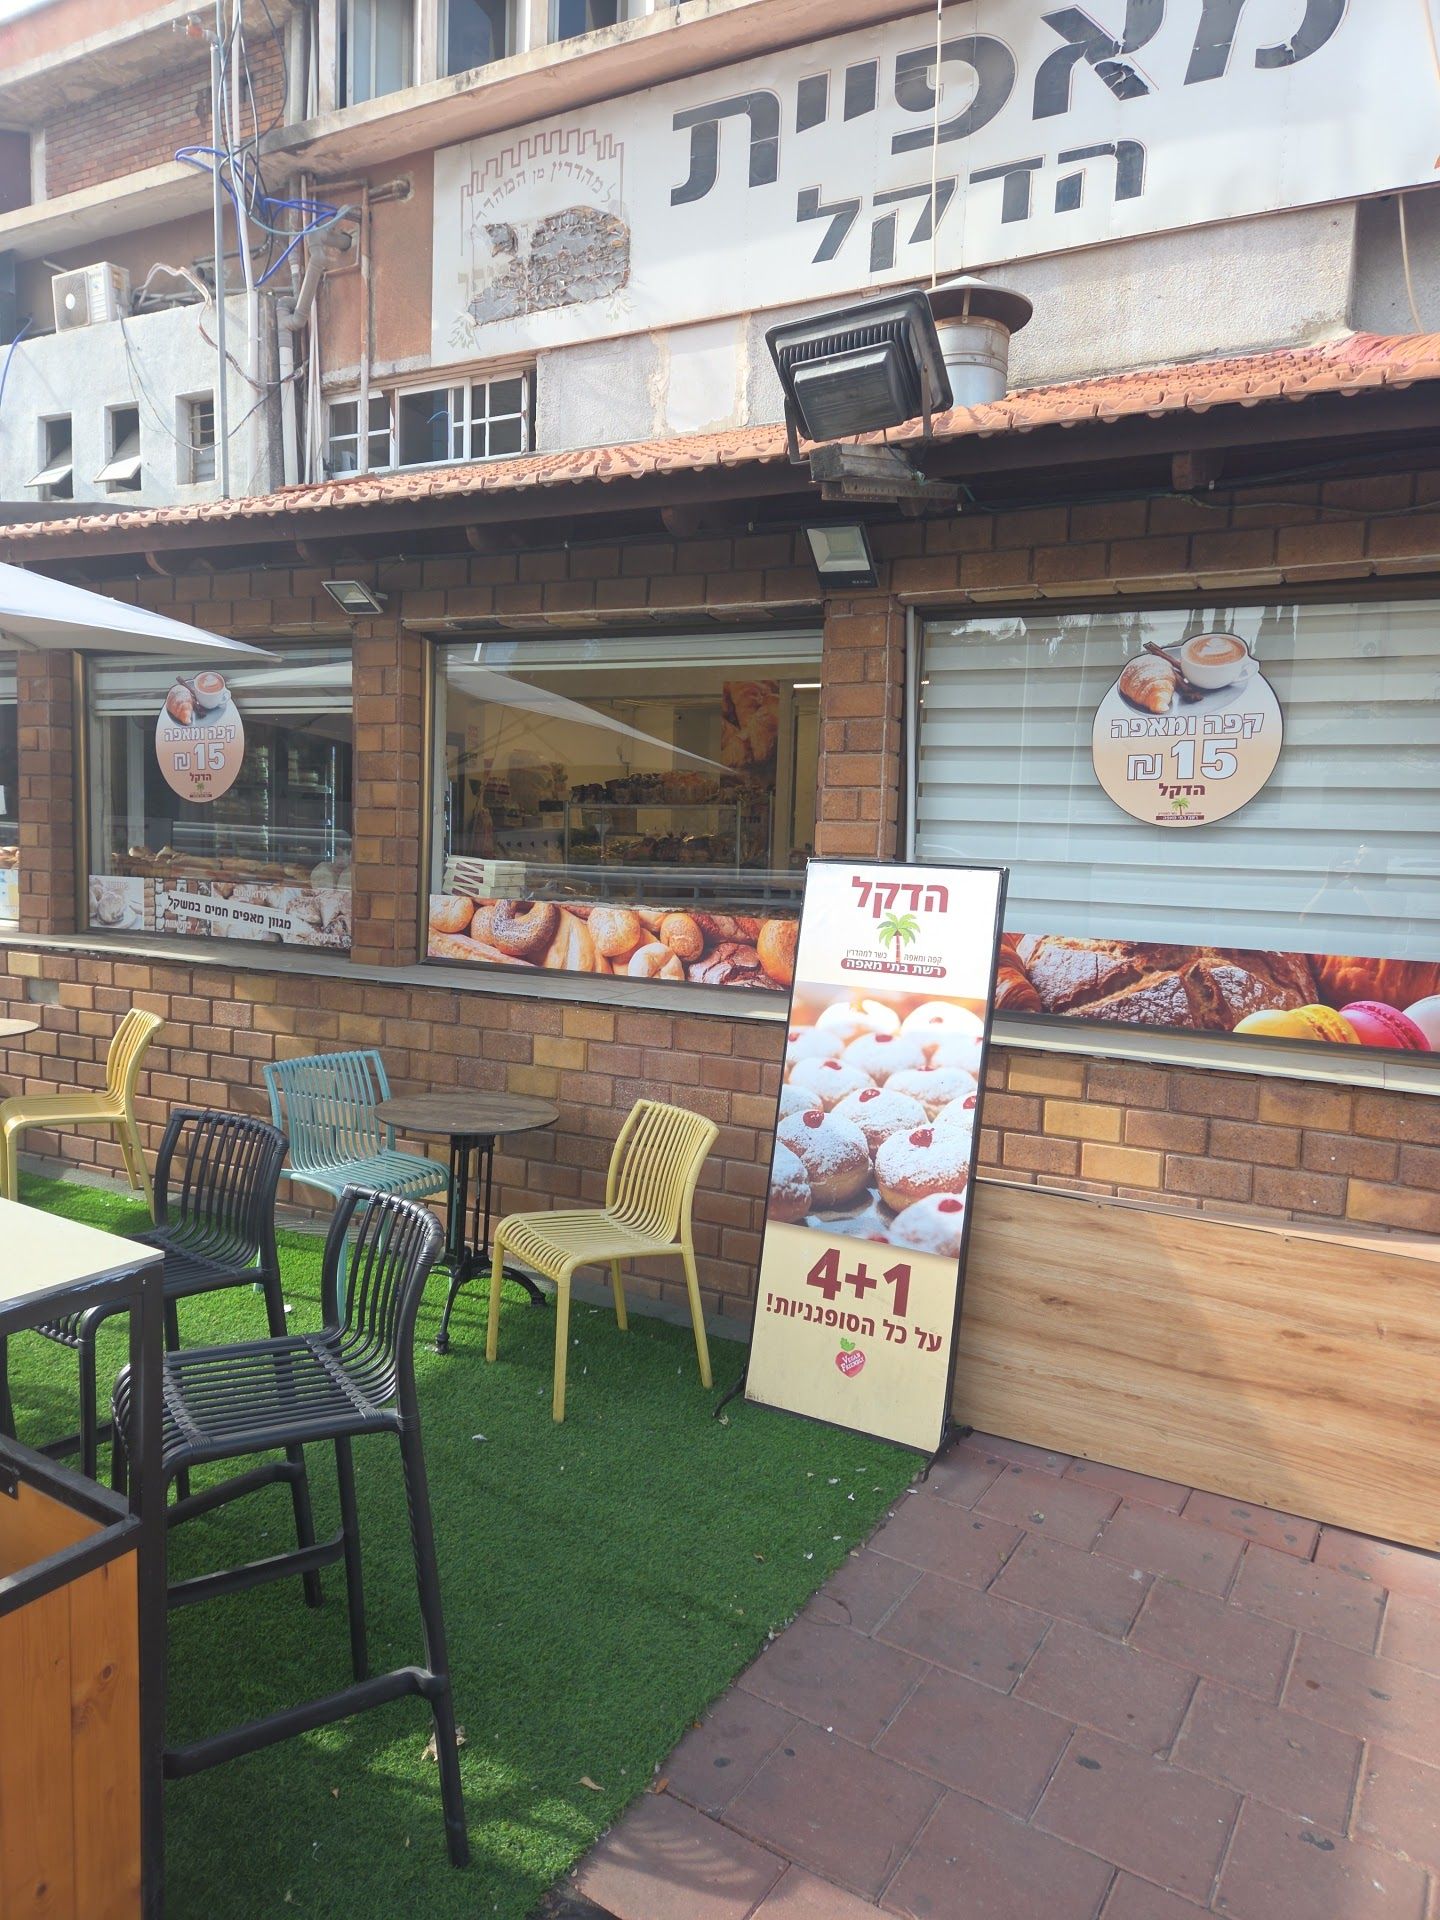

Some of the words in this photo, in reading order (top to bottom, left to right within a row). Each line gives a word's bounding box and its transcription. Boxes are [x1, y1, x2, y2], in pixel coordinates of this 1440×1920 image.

[671, 0, 1348, 207] מאפיית
[532, 168, 545, 184] מן
[797, 139, 1146, 273] הדקל
[207, 725, 236, 743] קפה
[1110, 715, 1197, 738] ומאפה
[1203, 712, 1265, 739] קפה
[164, 727, 205, 742] ומאפה
[194, 742, 225, 771] 15
[1170, 738, 1238, 780] 15
[189, 772, 212, 783] הדקל
[1158, 782, 1206, 799] הדקל
[168, 895, 201, 912] במשקל
[851, 875, 949, 919] הדקל
[204, 904, 229, 918] חמים
[232, 910, 264, 925] מאפים
[268, 916, 292, 930] מגוון
[874, 951, 888, 959] כשר
[903, 953, 926, 962] ומאפה
[927, 956, 942, 965] קפה
[846, 958, 883, 971] מאפה
[886, 962, 909, 974] בתי
[911, 965, 941, 976] רשת
[806, 1248, 912, 1318] 4+1
[766, 1292, 876, 1337] הסופגניות!
[882, 1319, 908, 1344] כל
[914, 1327, 943, 1352] על
